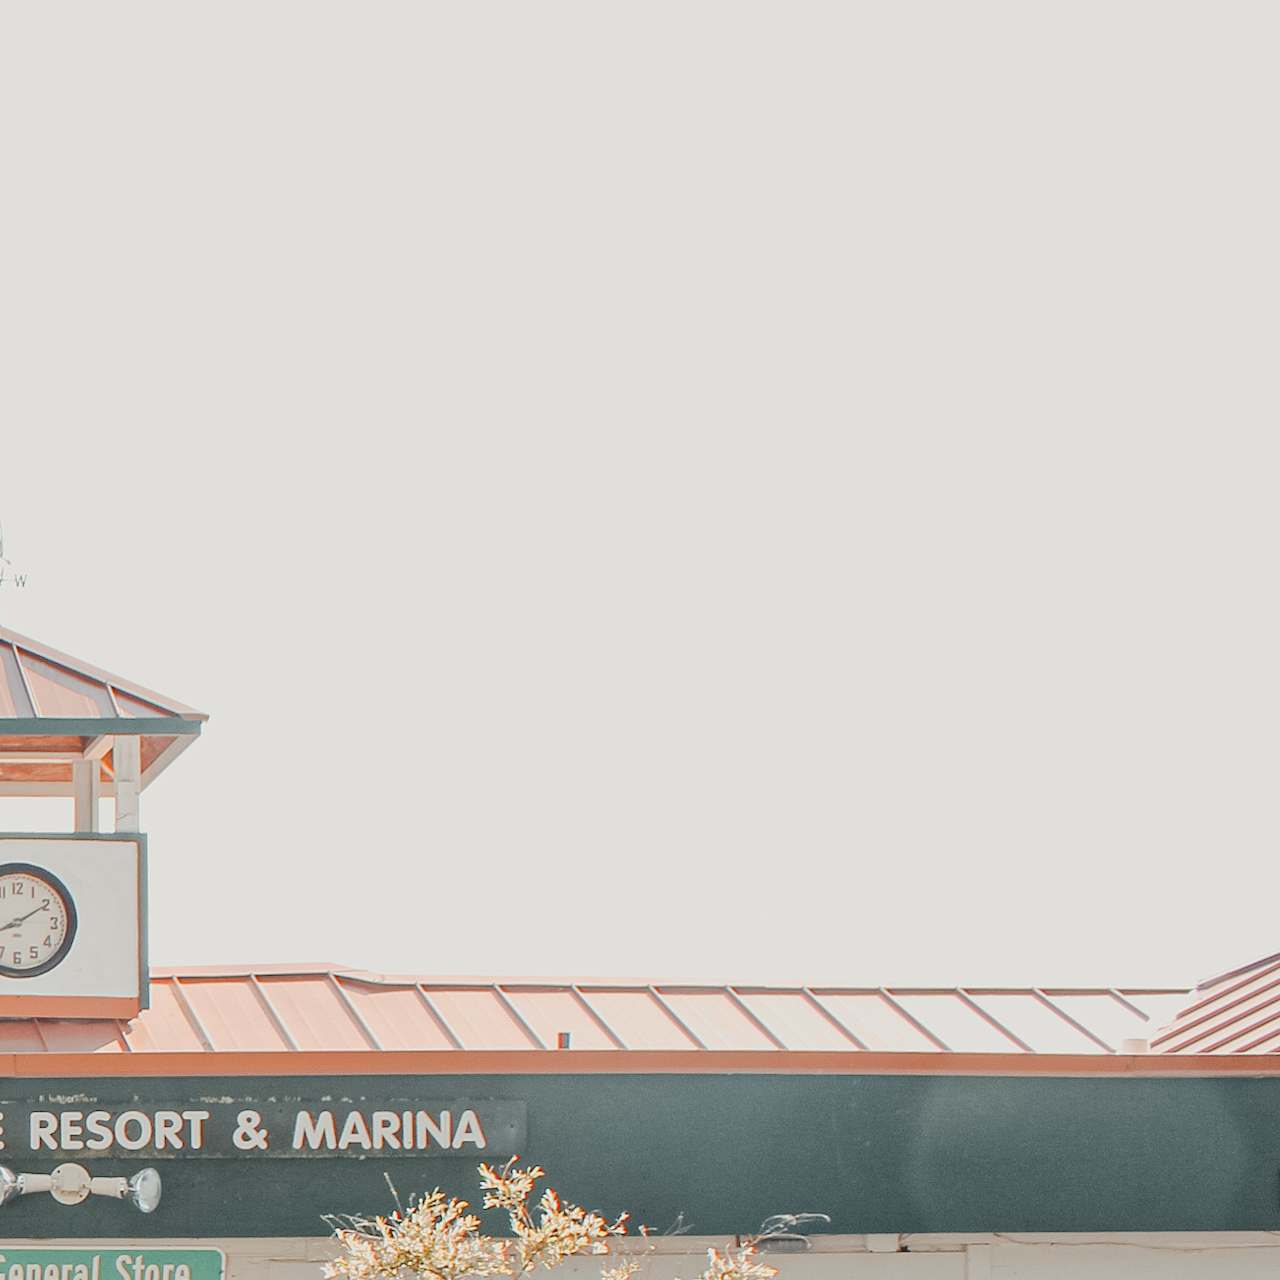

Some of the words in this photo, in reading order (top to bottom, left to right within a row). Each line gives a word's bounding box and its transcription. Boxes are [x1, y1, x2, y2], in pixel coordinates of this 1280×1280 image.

[12, 882, 24, 895] 12
[31, 886, 35, 898] 1
[42, 899, 50, 911] 2
[50, 917, 58, 930] 3
[43, 935, 52, 947] 4
[13, 951, 21, 964] 6
[30, 946, 38, 959] 5
[29, 1110, 209, 1151] RESORT
[232, 1109, 268, 1150] &
[292, 1109, 487, 1151] MARINA
